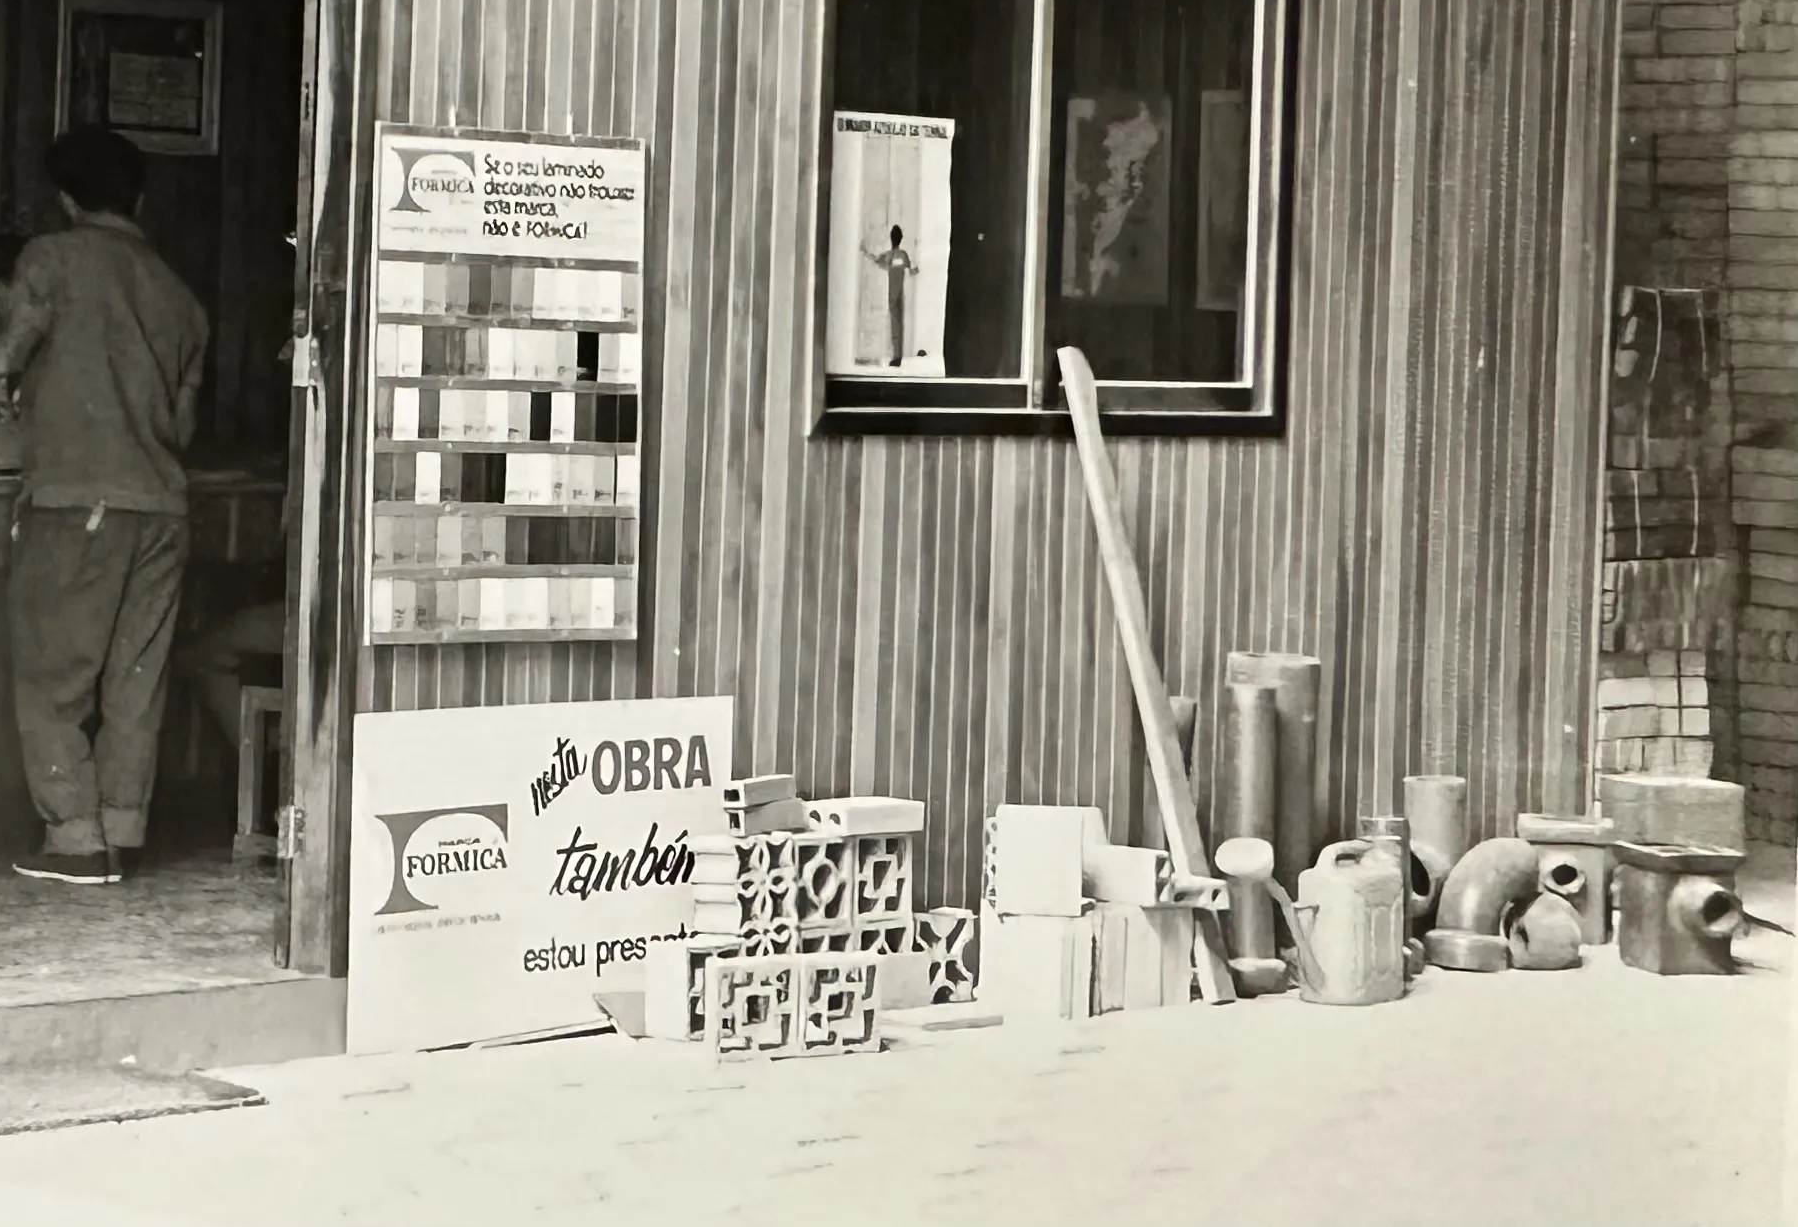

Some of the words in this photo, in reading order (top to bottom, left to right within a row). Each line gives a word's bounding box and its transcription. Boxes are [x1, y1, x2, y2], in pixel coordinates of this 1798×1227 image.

[484, 153, 501, 175] Se
[503, 161, 514, 176] o
[530, 736, 588, 817] nesta
[591, 734, 712, 796] OBRA
[406, 847, 508, 879] FORMICA
[523, 936, 586, 973] estou
[596, 922, 698, 978] pres
